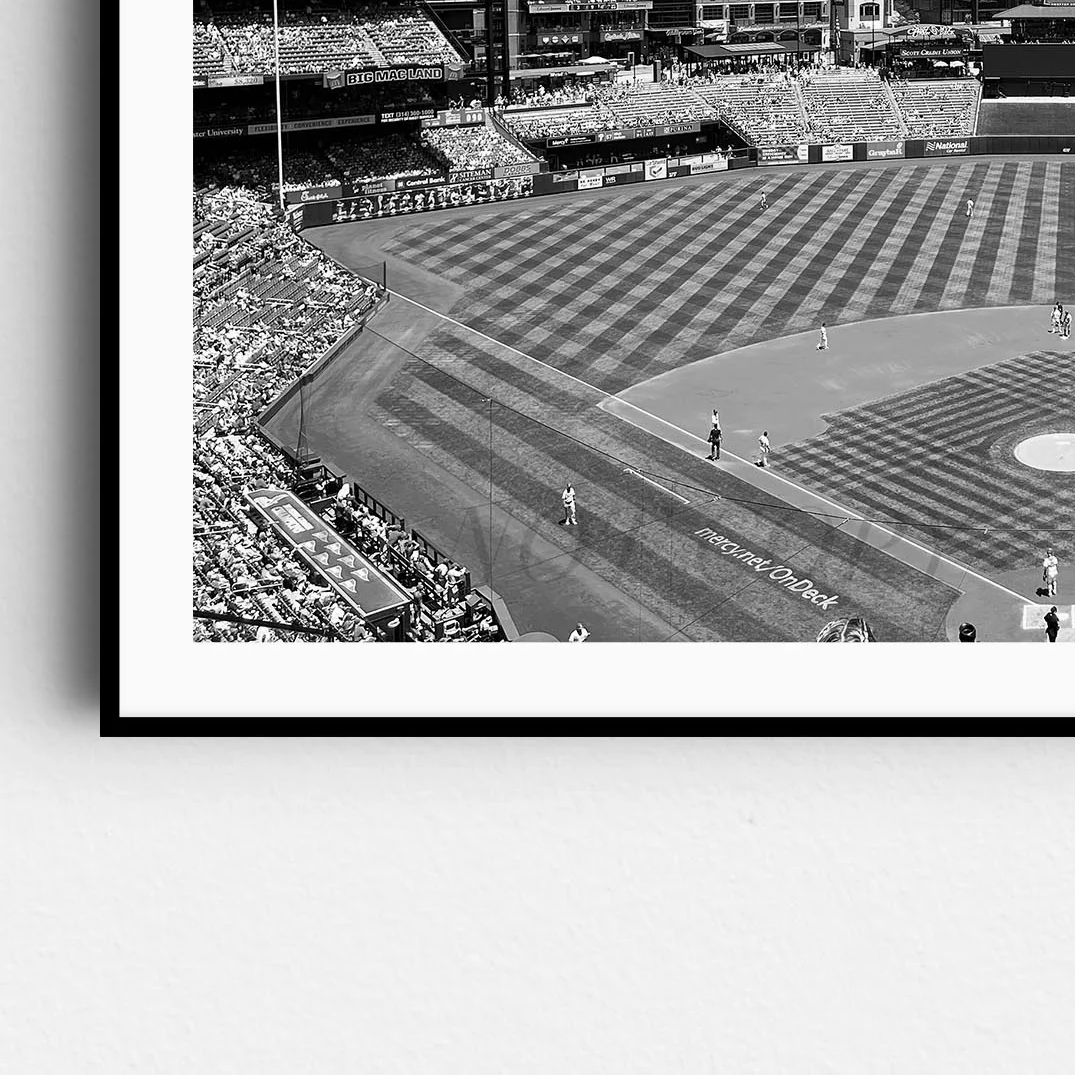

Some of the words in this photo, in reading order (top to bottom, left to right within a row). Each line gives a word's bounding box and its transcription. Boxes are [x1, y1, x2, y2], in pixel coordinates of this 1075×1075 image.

[346, 72, 374, 86] BIG
[374, 69, 407, 82] MAC
[407, 68, 443, 80] LAND
[395, 110, 409, 118] (314)
[207, 128, 244, 138] University
[671, 125, 693, 133] PURINA
[935, 141, 968, 151] National
[460, 168, 492, 178] SITEMAN
[406, 179, 428, 187] Central
[429, 177, 445, 185] Bank
[694, 527, 839, 611] mercy.net/OnDeck
